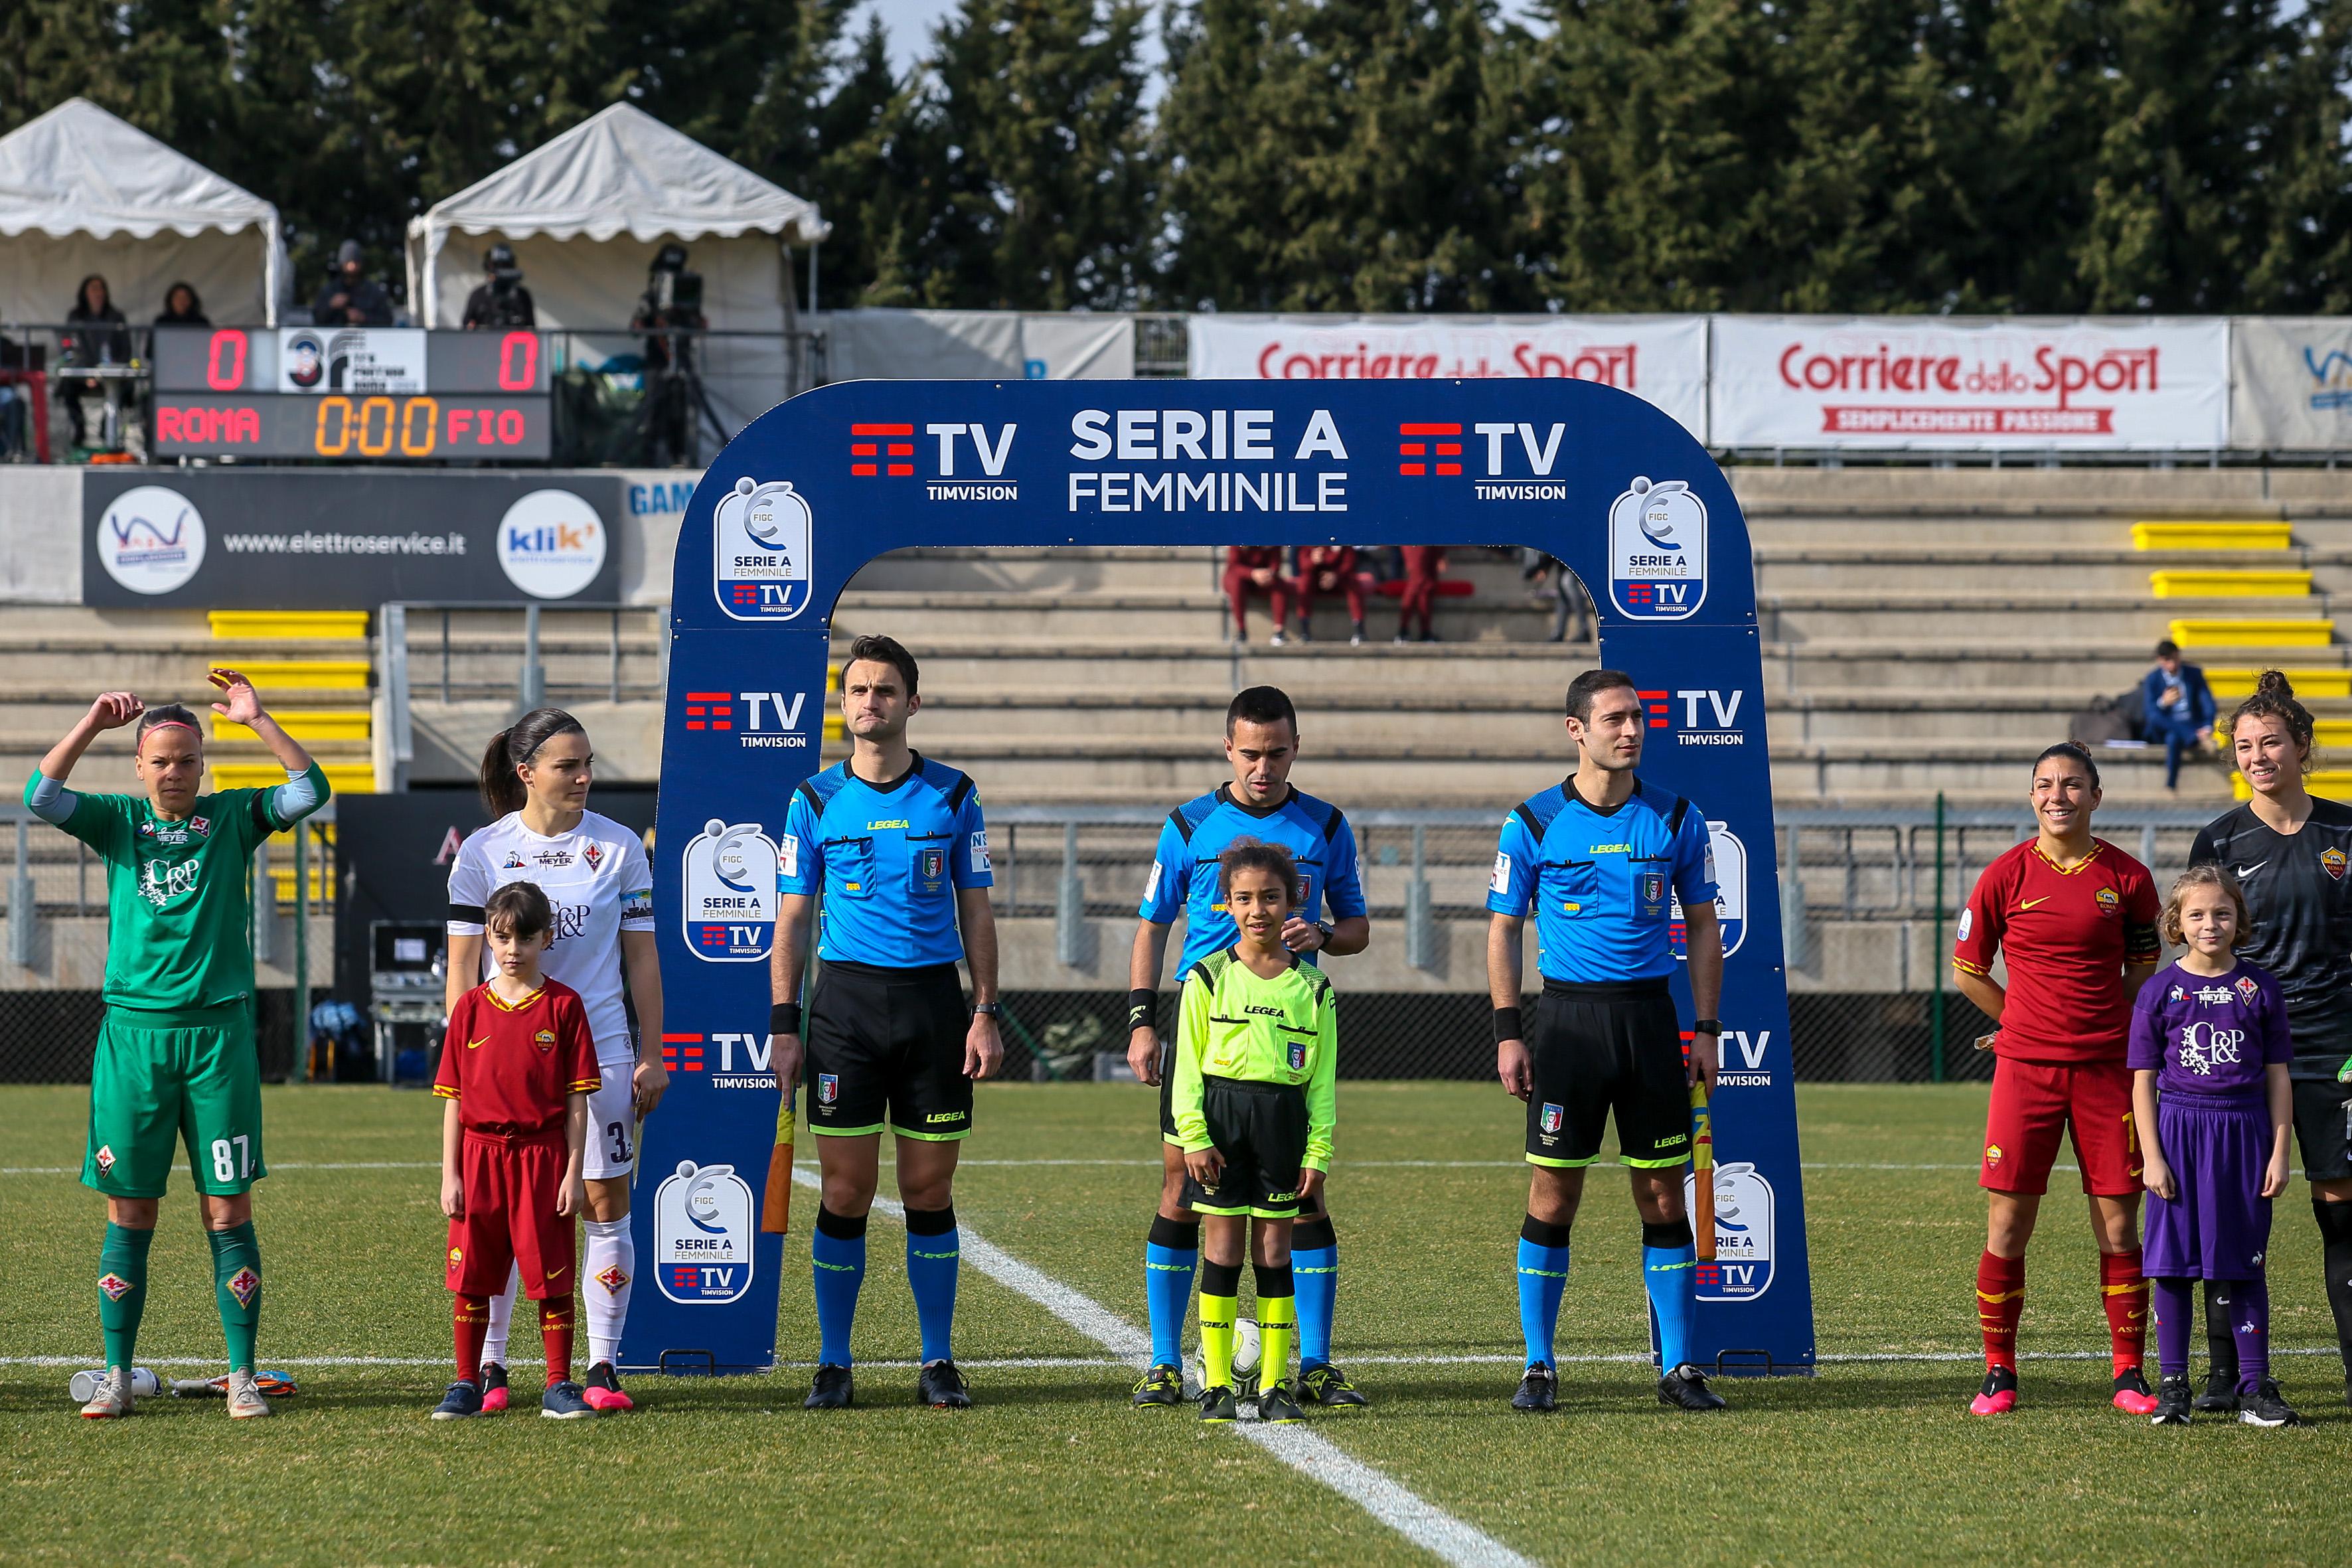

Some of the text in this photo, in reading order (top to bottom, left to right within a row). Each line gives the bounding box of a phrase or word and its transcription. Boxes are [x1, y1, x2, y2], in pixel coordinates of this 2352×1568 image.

[207, 329, 247, 391] 0
[499, 332, 538, 390] 0
[1780, 343, 1961, 391] Corriere
[2033, 345, 2159, 408] Sport
[157, 396, 525, 457] ROMA 0:00 FIO
[1837, 410, 2098, 431] SEMPLICEMENTE PASSIONE
[1069, 409, 1348, 460] SERIE A
[927, 424, 1017, 476] TV
[1474, 423, 1565, 475] TV
[927, 487, 1017, 500] TIMVISION
[1069, 473, 1348, 512] FEMMINILE
[1475, 486, 1566, 499] TIMVISION
[224, 530, 466, 554] www.elettroservice.it
[734, 556, 791, 566] SERIE A
[1629, 556, 1687, 566] SERIE A
[760, 585, 792, 604] TV
[1655, 584, 1687, 603] TV
[740, 693, 805, 730] TV
[1678, 690, 1743, 727] TV
[740, 737, 806, 747] TIMVISION
[1678, 735, 1743, 745] TIMVISION
[867, 820, 909, 830] LEGEA
[1589, 844, 1632, 854] LEGEA
[703, 898, 761, 908] SERIE A
[730, 927, 761, 945] TV
[1244, 1005, 1285, 1018] LEGEA
[712, 1034, 773, 1071] TV
[712, 1079, 777, 1089] TIMVISION
[1717, 1075, 1771, 1086] MVISION
[926, 1111, 965, 1123] LEGEA
[607, 1121, 626, 1164] 3
[1654, 1133, 1687, 1148] LEGEA
[212, 1135, 249, 1182] 87
[1268, 1191, 1296, 1202] LEGE
[675, 1239, 733, 1249] SERIE A
[1715, 1237, 1754, 1247] RIE A
[674, 1251, 733, 1260] FEMMINILE
[1717, 1249, 1755, 1257] MINILE
[701, 1268, 733, 1287] TV
[1722, 1265, 1755, 1285] TV
